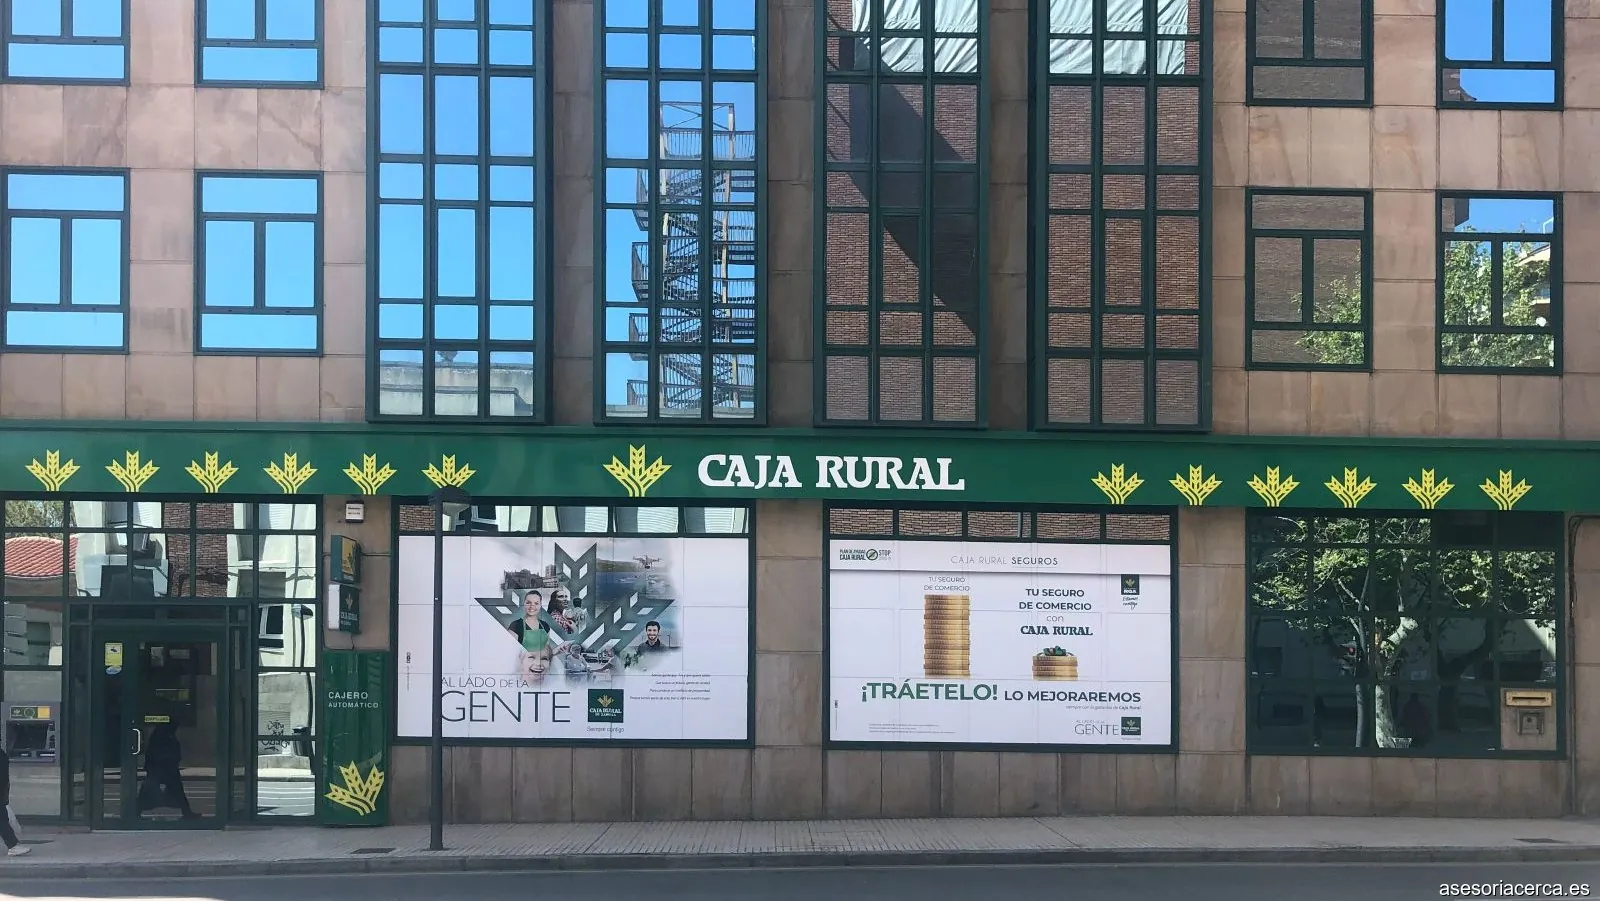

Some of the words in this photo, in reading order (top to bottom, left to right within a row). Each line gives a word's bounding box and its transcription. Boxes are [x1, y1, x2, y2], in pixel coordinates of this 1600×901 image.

[697, 454, 803, 490] CAJA
[815, 455, 966, 491] RURAL
[878, 549, 892, 557] STOP
[950, 555, 976, 565] CAJA
[978, 556, 1008, 566] RURAL
[1011, 556, 1059, 566] SEGUROS
[1025, 588, 1040, 597] TU
[1042, 588, 1085, 598] SEGURO
[1019, 601, 1034, 610] DE
[1035, 602, 1092, 611] COMERCIO
[1020, 625, 1050, 635] CAJA
[1052, 626, 1094, 636] RURAL
[442, 677, 455, 688] AL
[458, 677, 496, 688] LADO
[500, 679, 513, 688] DE
[516, 679, 530, 688] LA
[328, 691, 369, 700] CAJERO
[861, 679, 998, 703] ¡TRÁETELO!
[1004, 690, 1024, 702] LO
[1027, 691, 1142, 703] MEJORAREMOS
[328, 701, 379, 709] AUTOMÁTICO
[442, 690, 571, 723] GENTE
[1074, 724, 1119, 736] GENTE
